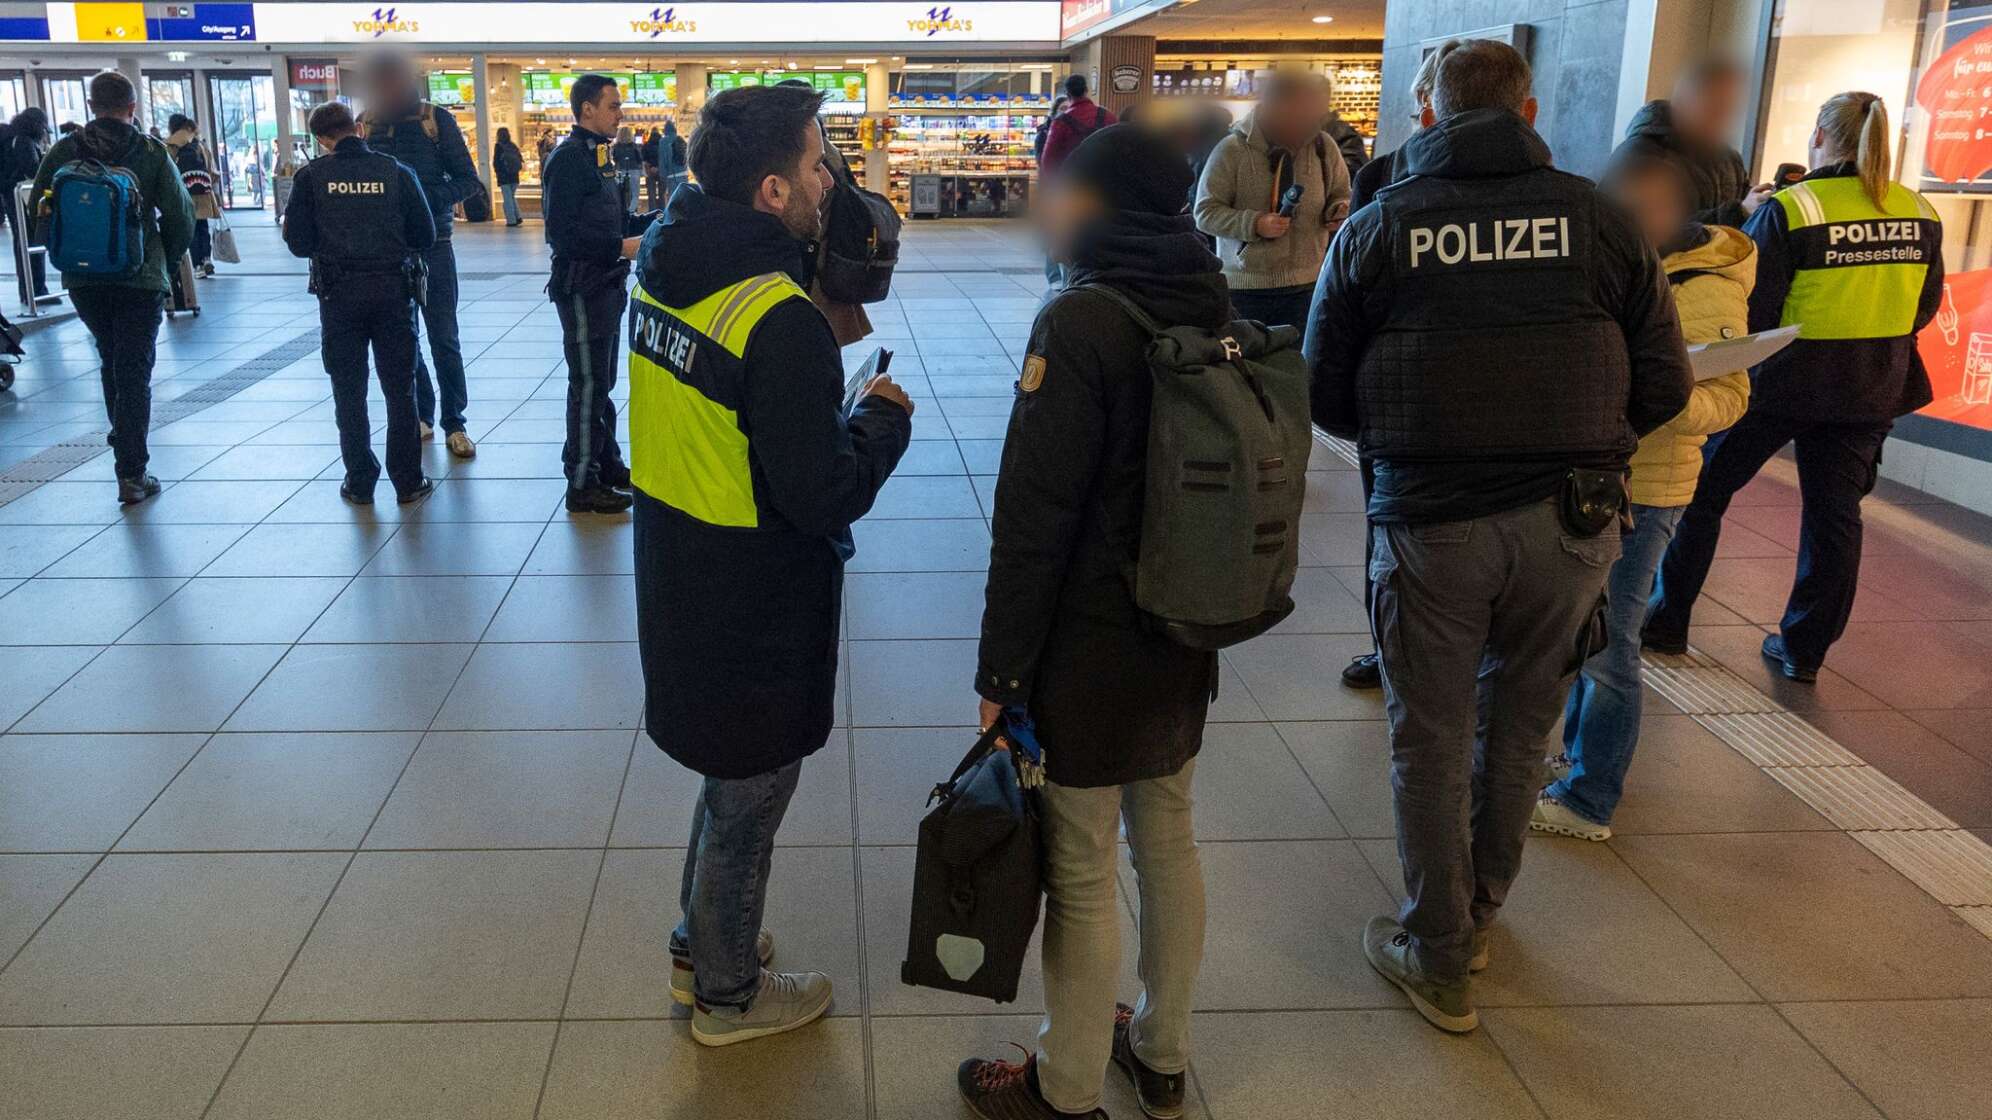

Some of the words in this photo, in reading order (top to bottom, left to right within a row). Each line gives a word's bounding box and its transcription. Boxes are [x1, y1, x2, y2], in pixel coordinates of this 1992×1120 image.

[1953, 57, 1974, 79] für
[327, 181, 385, 195] POLIZEI
[1410, 216, 1570, 268] POLIZEI
[1828, 220, 1921, 246] POLIZEI
[1824, 245, 1924, 267] Pressestelle
[634, 311, 697, 375] POLIZEI
